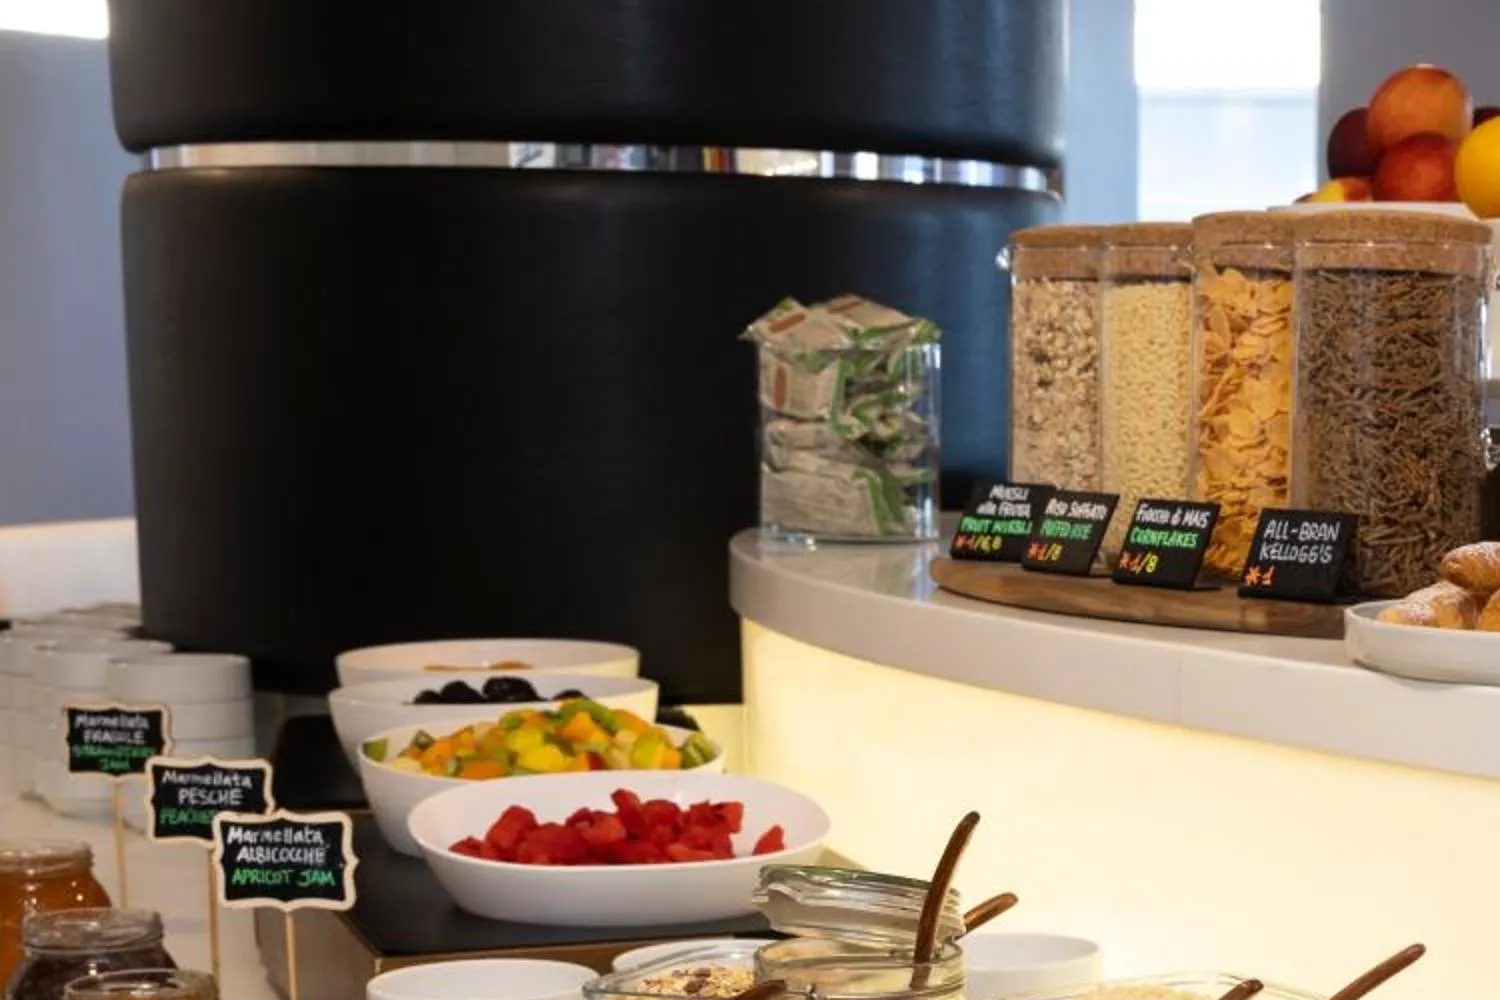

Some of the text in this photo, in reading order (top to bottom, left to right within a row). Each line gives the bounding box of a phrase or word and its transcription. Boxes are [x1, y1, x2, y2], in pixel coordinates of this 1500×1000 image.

[1182, 508, 1212, 529] MAIS
[1129, 525, 1199, 549] CORNFLAKES
[1263, 518, 1341, 541] ALL-BRAN
[161, 770, 253, 788] Marmellata
[177, 787, 244, 805] PESCHE
[227, 826, 324, 845] Marmellata
[237, 845, 327, 866] ALBICOCCHE
[232, 867, 336, 887] APRICOT JAM
